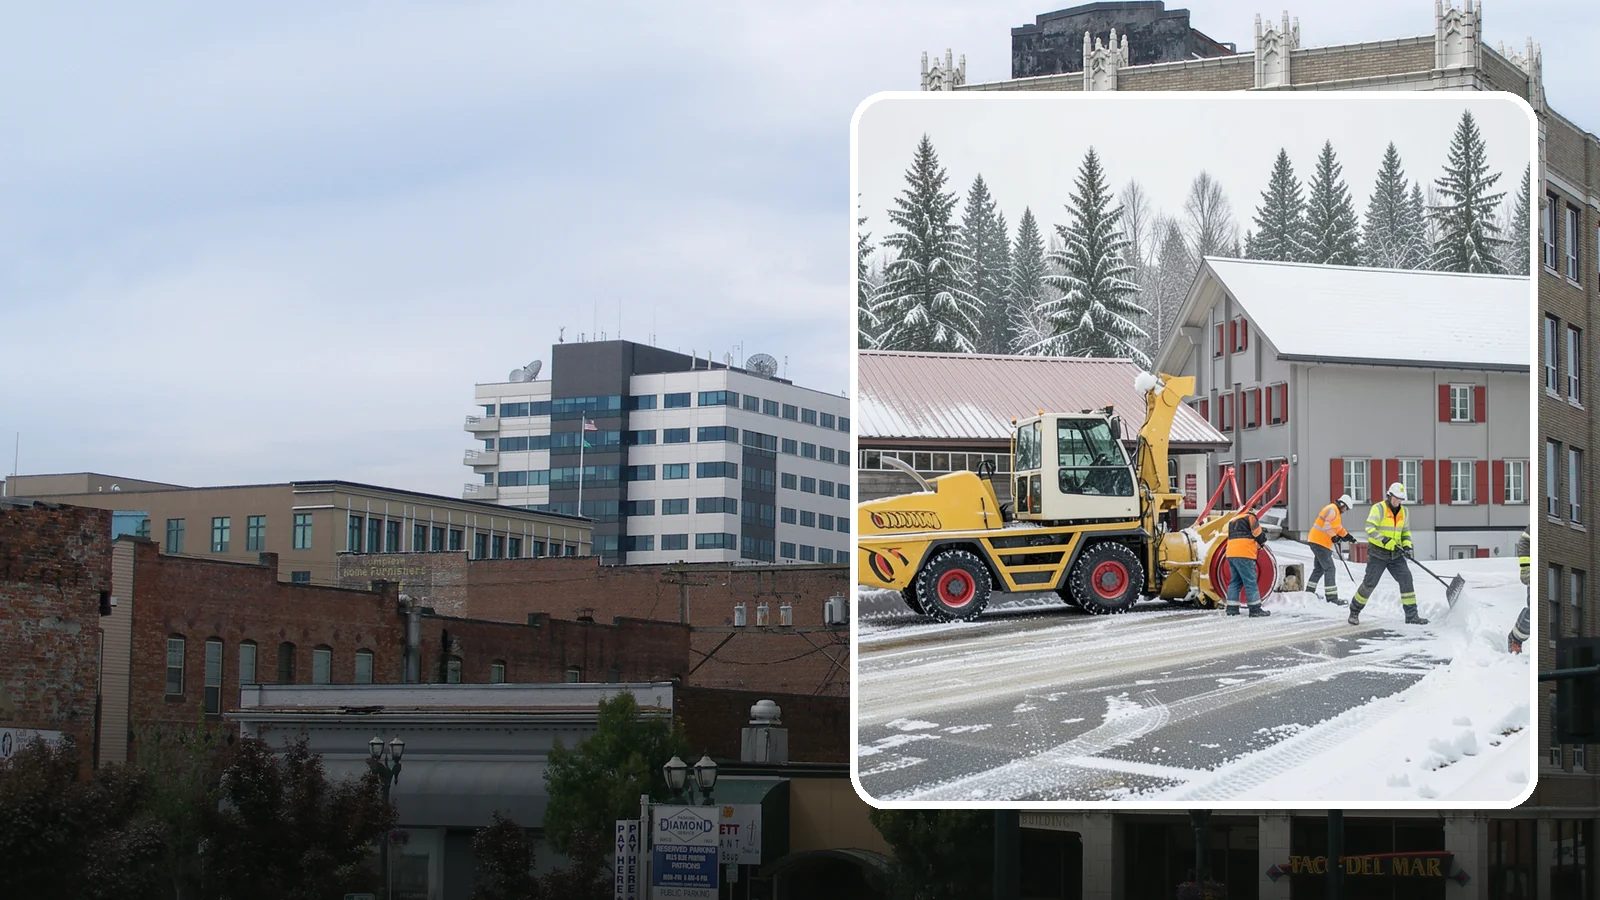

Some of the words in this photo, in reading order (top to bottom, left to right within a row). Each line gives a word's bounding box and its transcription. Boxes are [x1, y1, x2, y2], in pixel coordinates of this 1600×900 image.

[370, 566, 427, 576] Furnishers
[660, 818, 713, 832] DIAMOND
[1022, 815, 1070, 827] BUILDING
[617, 825, 625, 852] PAY
[628, 824, 636, 852] PAY
[656, 845, 688, 853] RESERVED
[689, 846, 716, 854] PARKING
[721, 851, 739, 862] Soup
[671, 862, 701, 870] PATRONS
[1346, 856, 1385, 875] DEL
[1392, 857, 1442, 877] MAR
[616, 856, 625, 893] HERE
[627, 856, 636, 893] HERE
[660, 888, 682, 897] PUBLIC
[684, 889, 710, 898] PARKING
